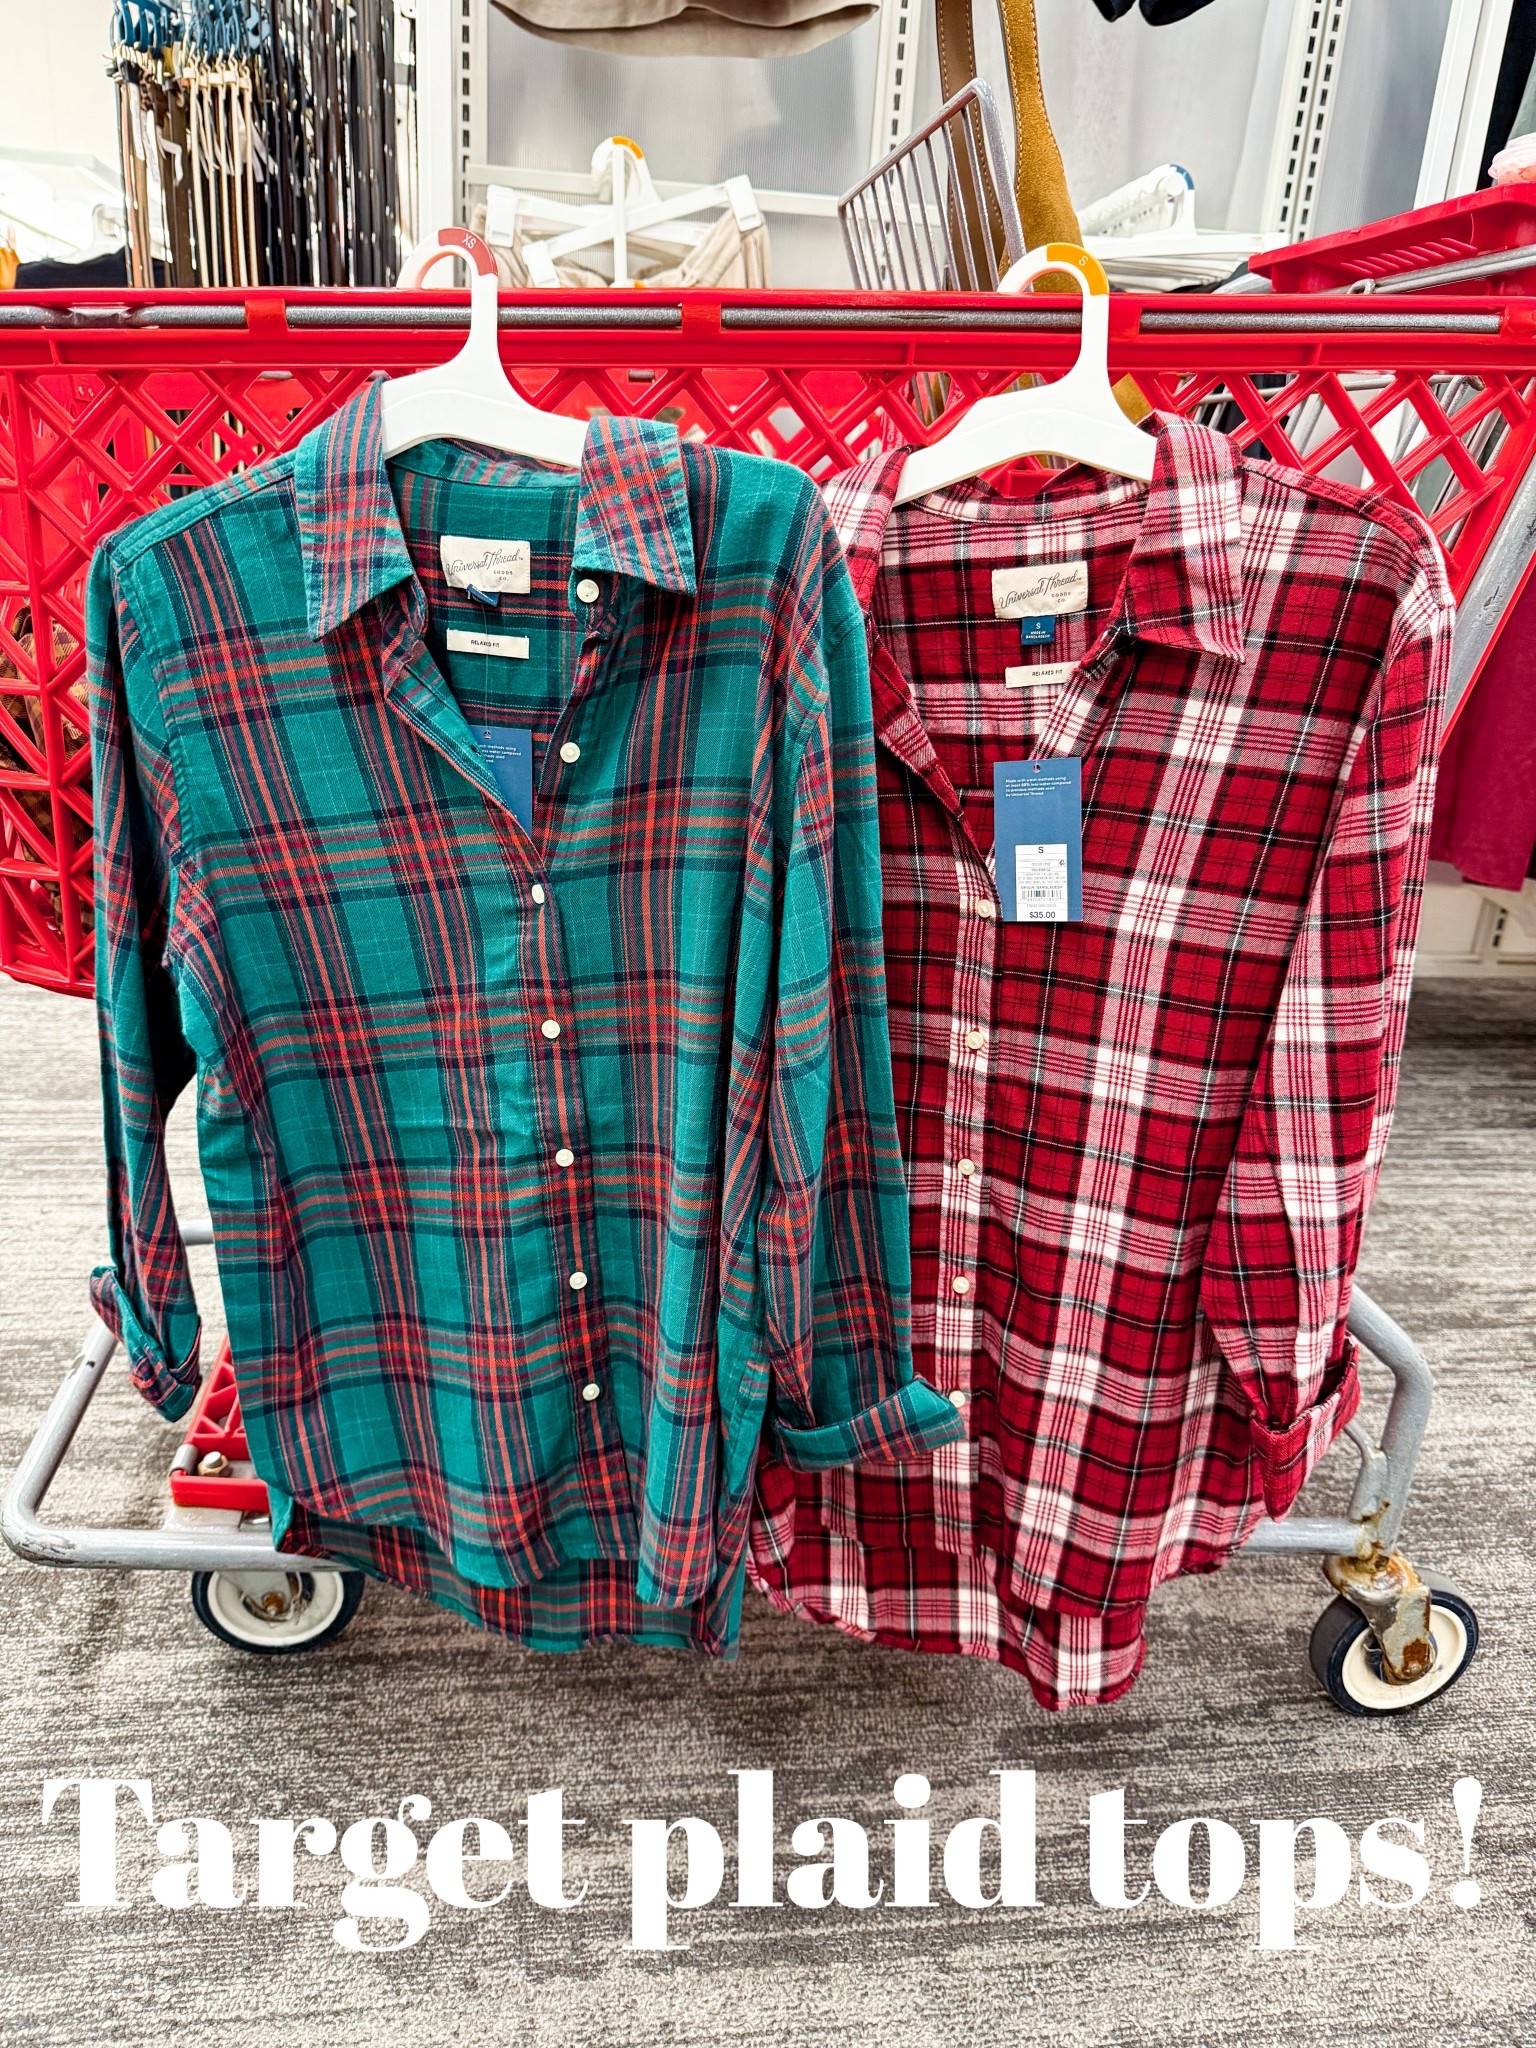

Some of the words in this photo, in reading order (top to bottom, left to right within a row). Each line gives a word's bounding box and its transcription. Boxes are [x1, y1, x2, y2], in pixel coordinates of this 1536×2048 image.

[461, 232, 478, 250] XS
[1078, 255, 1089, 267] S
[446, 554, 488, 575] Universal
[999, 579, 1044, 609] Universal
[470, 639, 492, 648] RELAXED
[1038, 846, 1044, 854] S
[1029, 911, 1056, 919] $35.00
